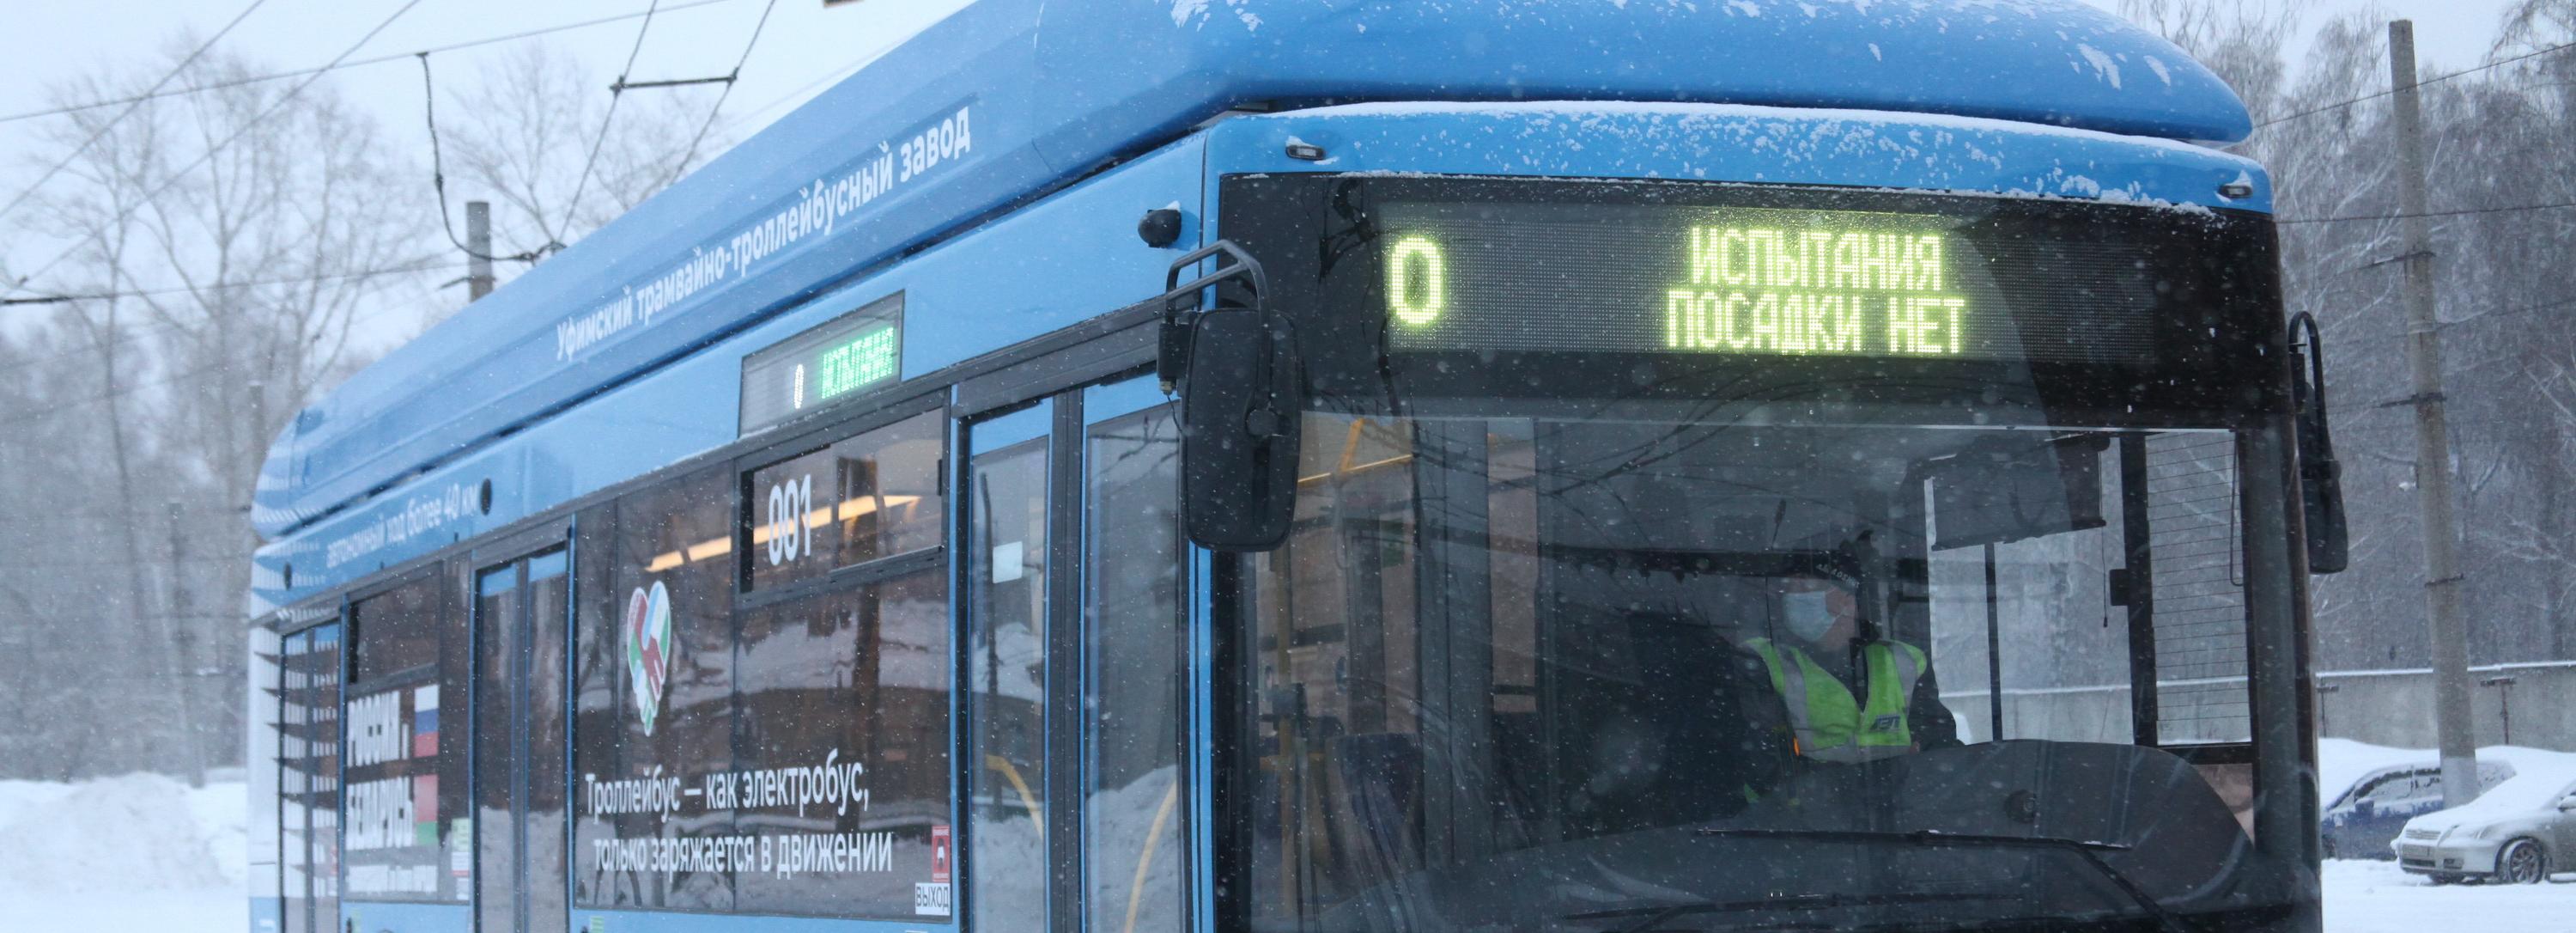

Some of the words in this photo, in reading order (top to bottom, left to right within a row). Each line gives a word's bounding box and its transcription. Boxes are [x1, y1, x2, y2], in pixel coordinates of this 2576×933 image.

[556, 284, 632, 362] Уфимский
[635, 140, 894, 326] трамвайно-троллейбусный
[899, 105, 971, 183] завод
[1691, 227, 1942, 291] ИСПЫТАНИЯ
[1388, 235, 1445, 326] 0
[1668, 290, 1862, 354] ПОСАДКИ
[1888, 296, 1965, 354] НЕТ
[407, 497, 441, 537] более
[769, 473, 811, 565] 001
[585, 765, 681, 824] Троллейбус
[706, 776, 738, 809] как
[743, 747, 870, 817] электробус,
[593, 838, 647, 871] только
[650, 835, 755, 881] заряжается
[761, 837, 771, 872] в
[776, 832, 893, 880] движении
[915, 886, 950, 912] ВЫХОД
